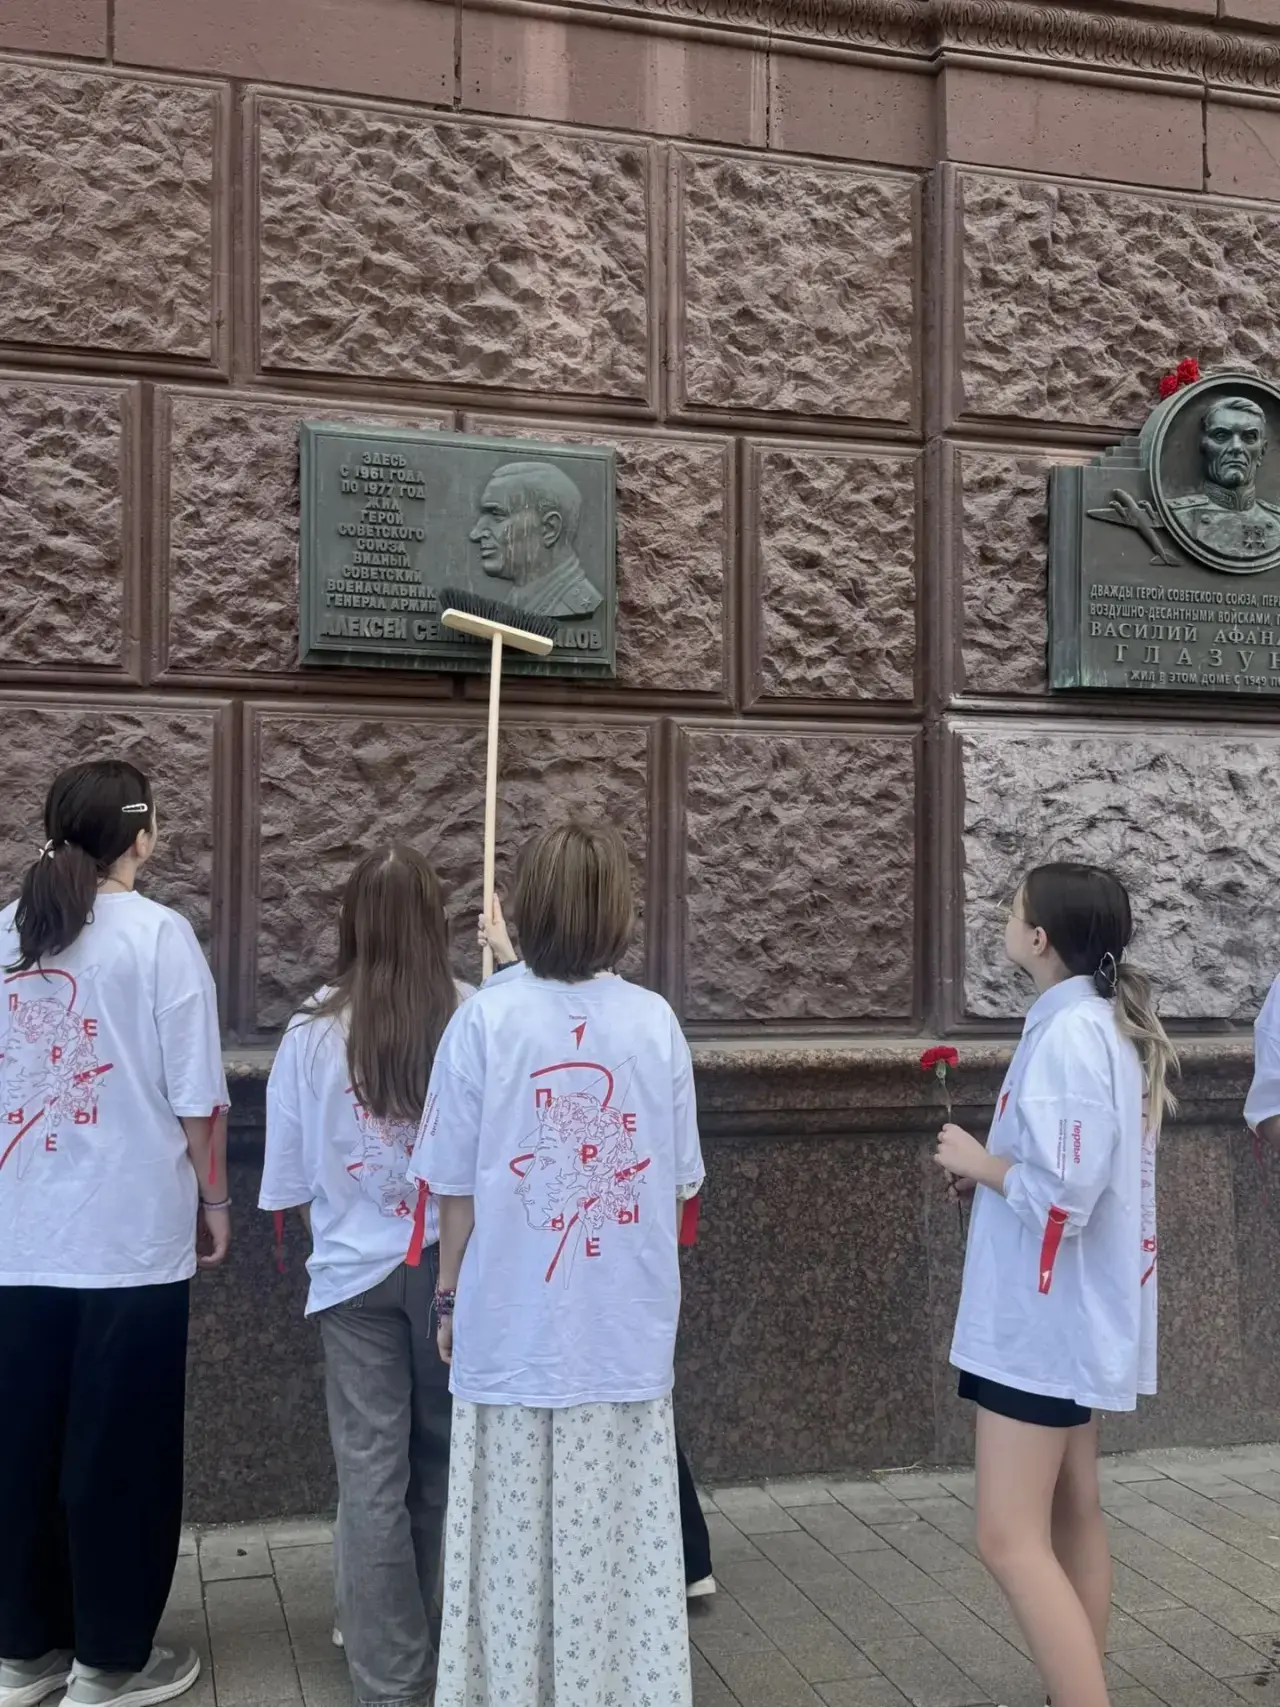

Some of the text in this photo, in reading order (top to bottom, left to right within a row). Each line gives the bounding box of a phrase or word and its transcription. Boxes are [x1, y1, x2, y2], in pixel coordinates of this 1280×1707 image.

[362, 452, 407, 467] ЗДЕСЬ
[340, 464, 426, 484] С 1961 ГОДА
[341, 480, 425, 499] ПО 1977 ГОД
[365, 496, 400, 511] ЖИЛ
[360, 510, 404, 526] ГЕРОЙ
[339, 523, 425, 541] СОВЕТСКОГО
[357, 539, 407, 554] СОЮЗА
[352, 551, 411, 567] ВИДНЫЙ
[342, 565, 422, 584] СОВЕТСКИЙ
[326, 579, 437, 599] ВОЕНАЧАЛЬНИК
[1091, 584, 1280, 607] ДВАЖДЫ ГЕРОЙ СОВЕТСКОГО СОЮЗА, ПЕР
[325, 593, 437, 613] ГЕНЕРАЛ АРМИИ
[1090, 602, 1215, 623] ВОЗДУШНО-ДЕСАНТНЫМИ
[1218, 608, 1273, 626] ВОЙСКАМИ,
[1091, 621, 1280, 646] ВАСИЛИЙ АФАН
[1130, 669, 1155, 681] ЖИЛ
[1169, 672, 1197, 684] ЭТОМ
[1201, 673, 1231, 687] ДОМЕ
[1244, 675, 1267, 686] 1949
[83, 1019, 98, 1036] Е
[622, 1113, 637, 1132] Е
[1072, 1119, 1083, 1165] Первые
[581, 1144, 598, 1164] Р
[585, 1237, 601, 1258] Е
